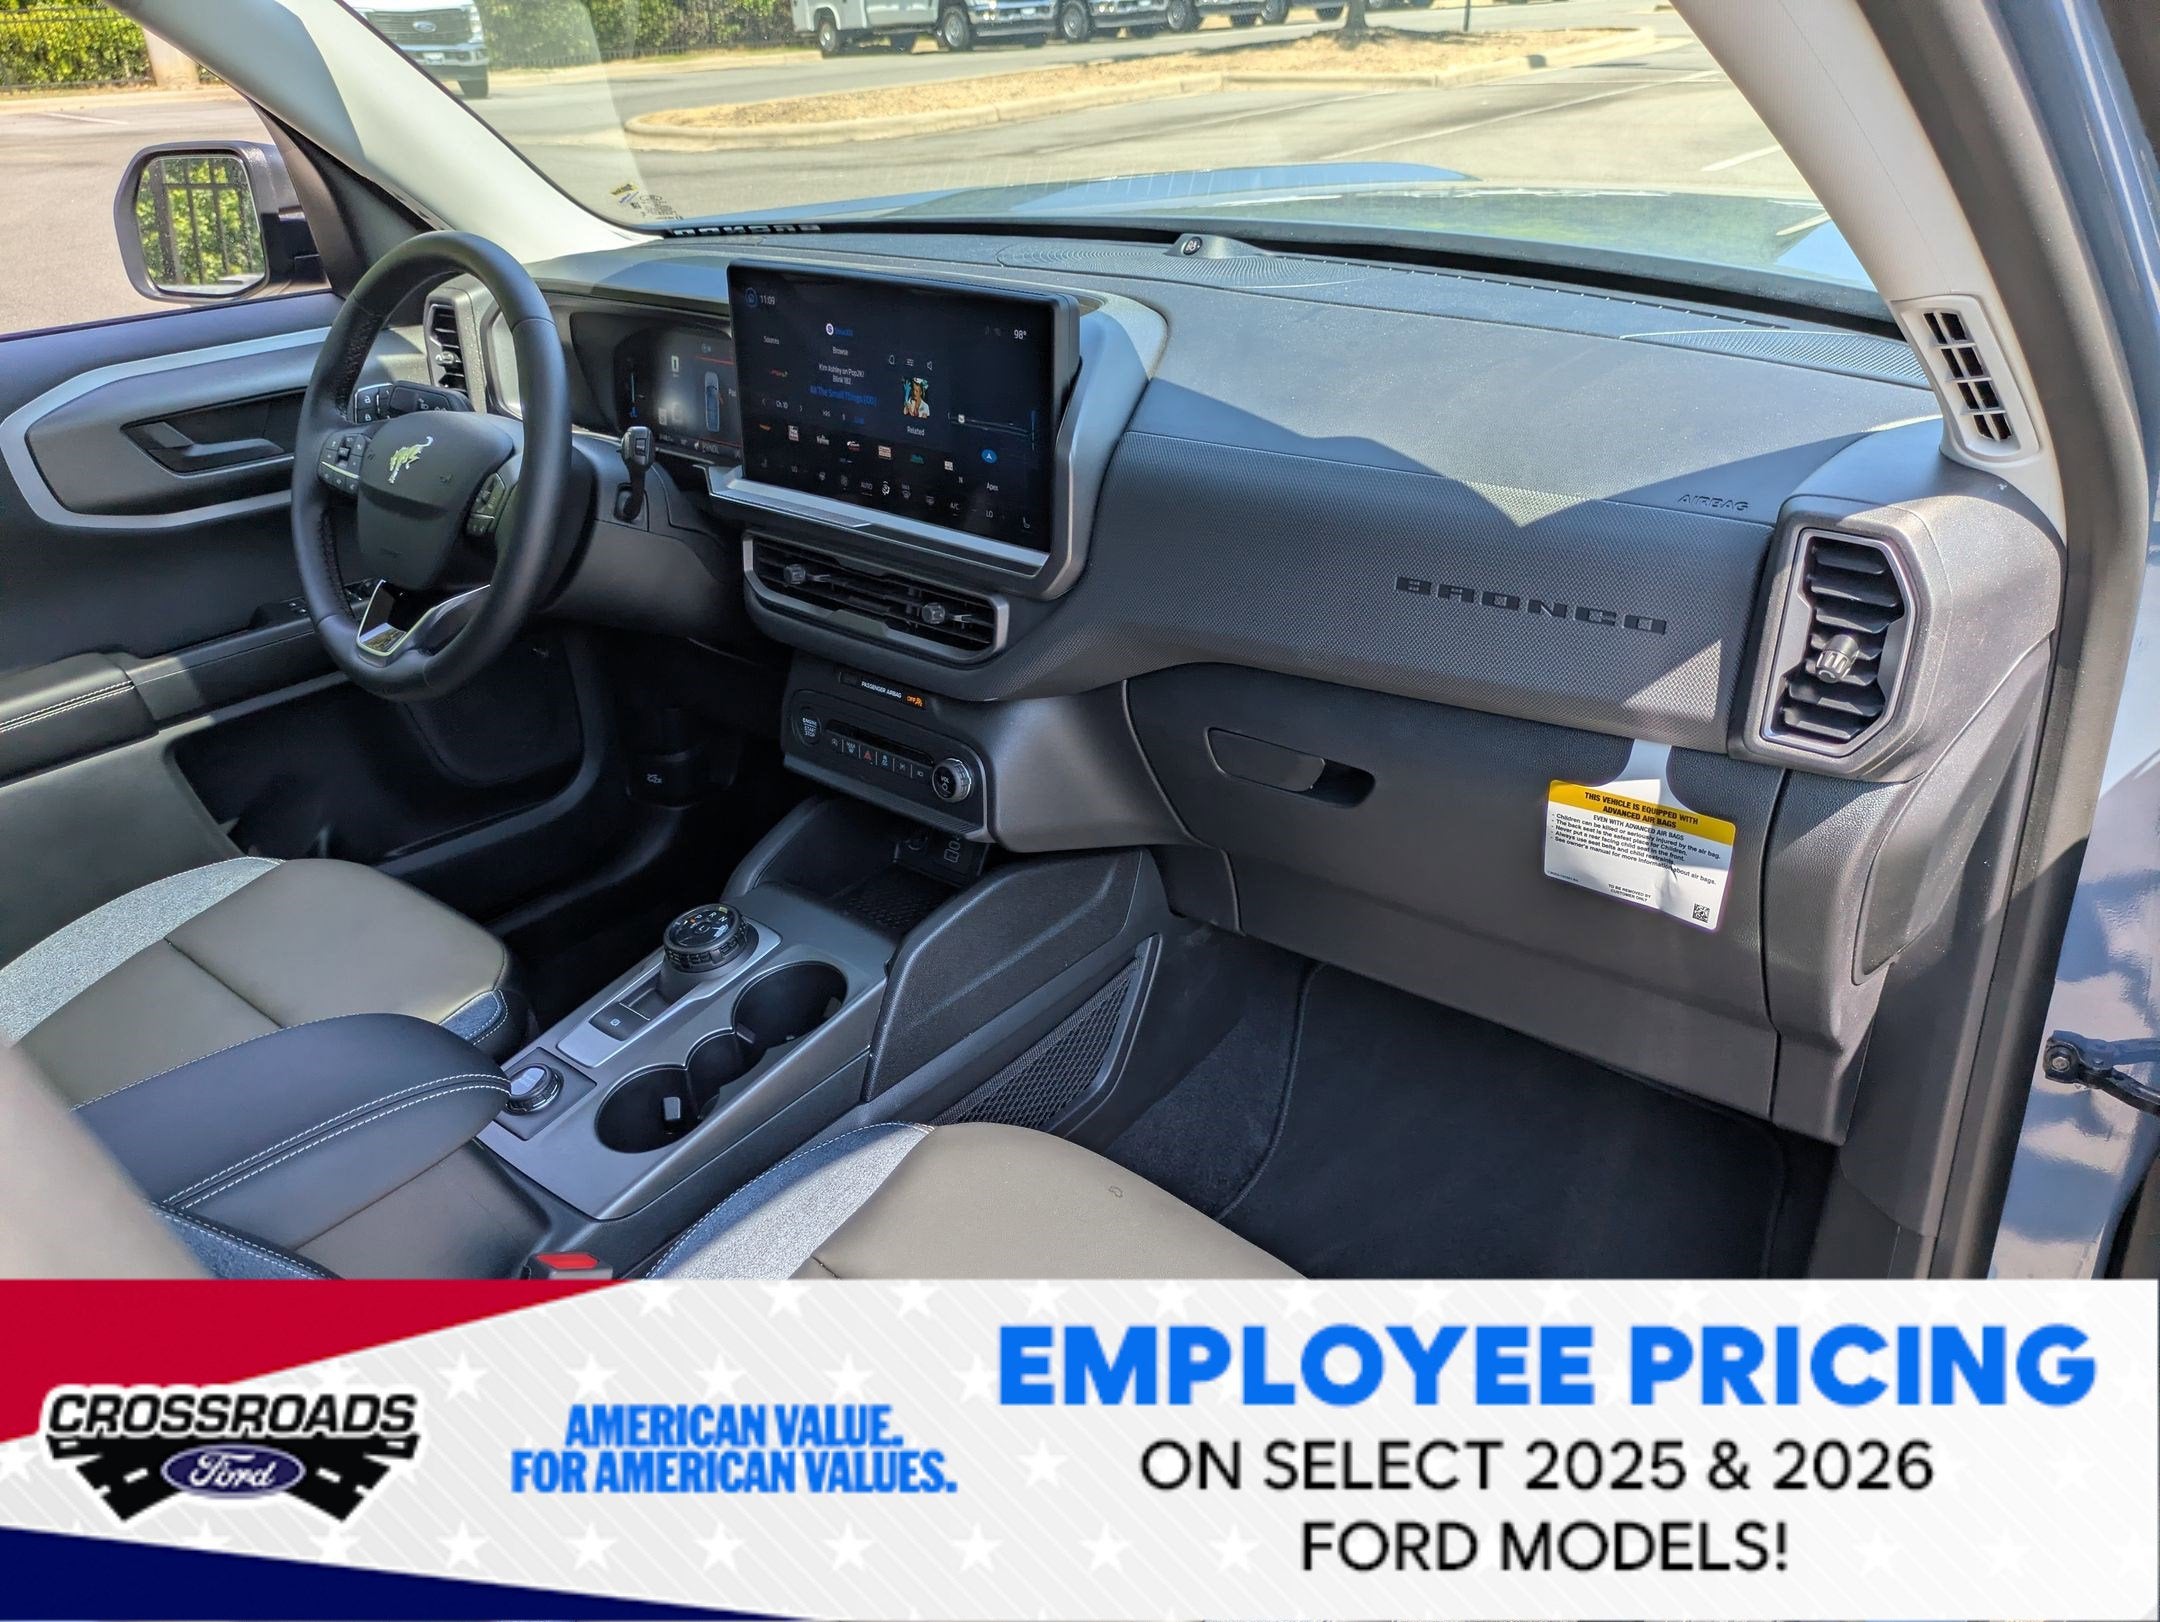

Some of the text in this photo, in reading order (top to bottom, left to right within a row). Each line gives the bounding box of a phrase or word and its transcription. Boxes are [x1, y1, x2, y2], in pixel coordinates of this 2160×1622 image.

[760, 295, 775, 305] 11:09
[1677, 493, 1750, 512] AIRBAG
[1395, 576, 1667, 635] BRONCO
[861, 681, 886, 693] PASSENGER
[886, 689, 902, 699] AIRBAG
[940, 776, 950, 784] VOL
[1584, 792, 1601, 802] THIS
[1602, 796, 1631, 809] VEHICLE
[1642, 806, 1678, 820] EQUIPPED
[1680, 814, 1699, 825] WITH
[1602, 806, 1676, 829] ADVANCED AIR BAGS
[1556, 813, 1581, 824] Children
[1602, 824, 1618, 832] killed
[1627, 831, 1654, 842] seriously
[1656, 836, 1678, 846] injured
[1678, 842, 1686, 850] by
[1687, 844, 1698, 852] the
[1707, 850, 1720, 860] bag.
[1568, 822, 1582, 830] back
[1582, 826, 1596, 834] seat
[1602, 830, 1612, 838] the
[1613, 832, 1632, 842] safest
[1632, 838, 1650, 846] place
[1660, 844, 1687, 856] Children.
[1593, 814, 1608, 824] EVEN
[1609, 818, 1624, 827] WITH
[1625, 822, 1656, 834] ADVANCED
[1668, 832, 1684, 841] BAGS
[1555, 831, 1576, 840] Always
[1602, 842, 1616, 850] belts
[1630, 849, 1644, 857] child
[1556, 826, 1572, 834] Never
[1602, 836, 1620, 846] facing
[1620, 841, 1636, 849] child
[1670, 852, 1685, 862] front.
[1554, 836, 1566, 844] See
[1566, 840, 1588, 850] owner's
[1590, 846, 1611, 855] manual
[1622, 854, 1638, 862] more
[1638, 857, 1672, 870] information
[1674, 867, 1690, 876] about
[1700, 876, 1716, 885] bags.
[1610, 888, 1636, 898] CUSTOMER
[1622, 888, 1644, 897] REMOVED
